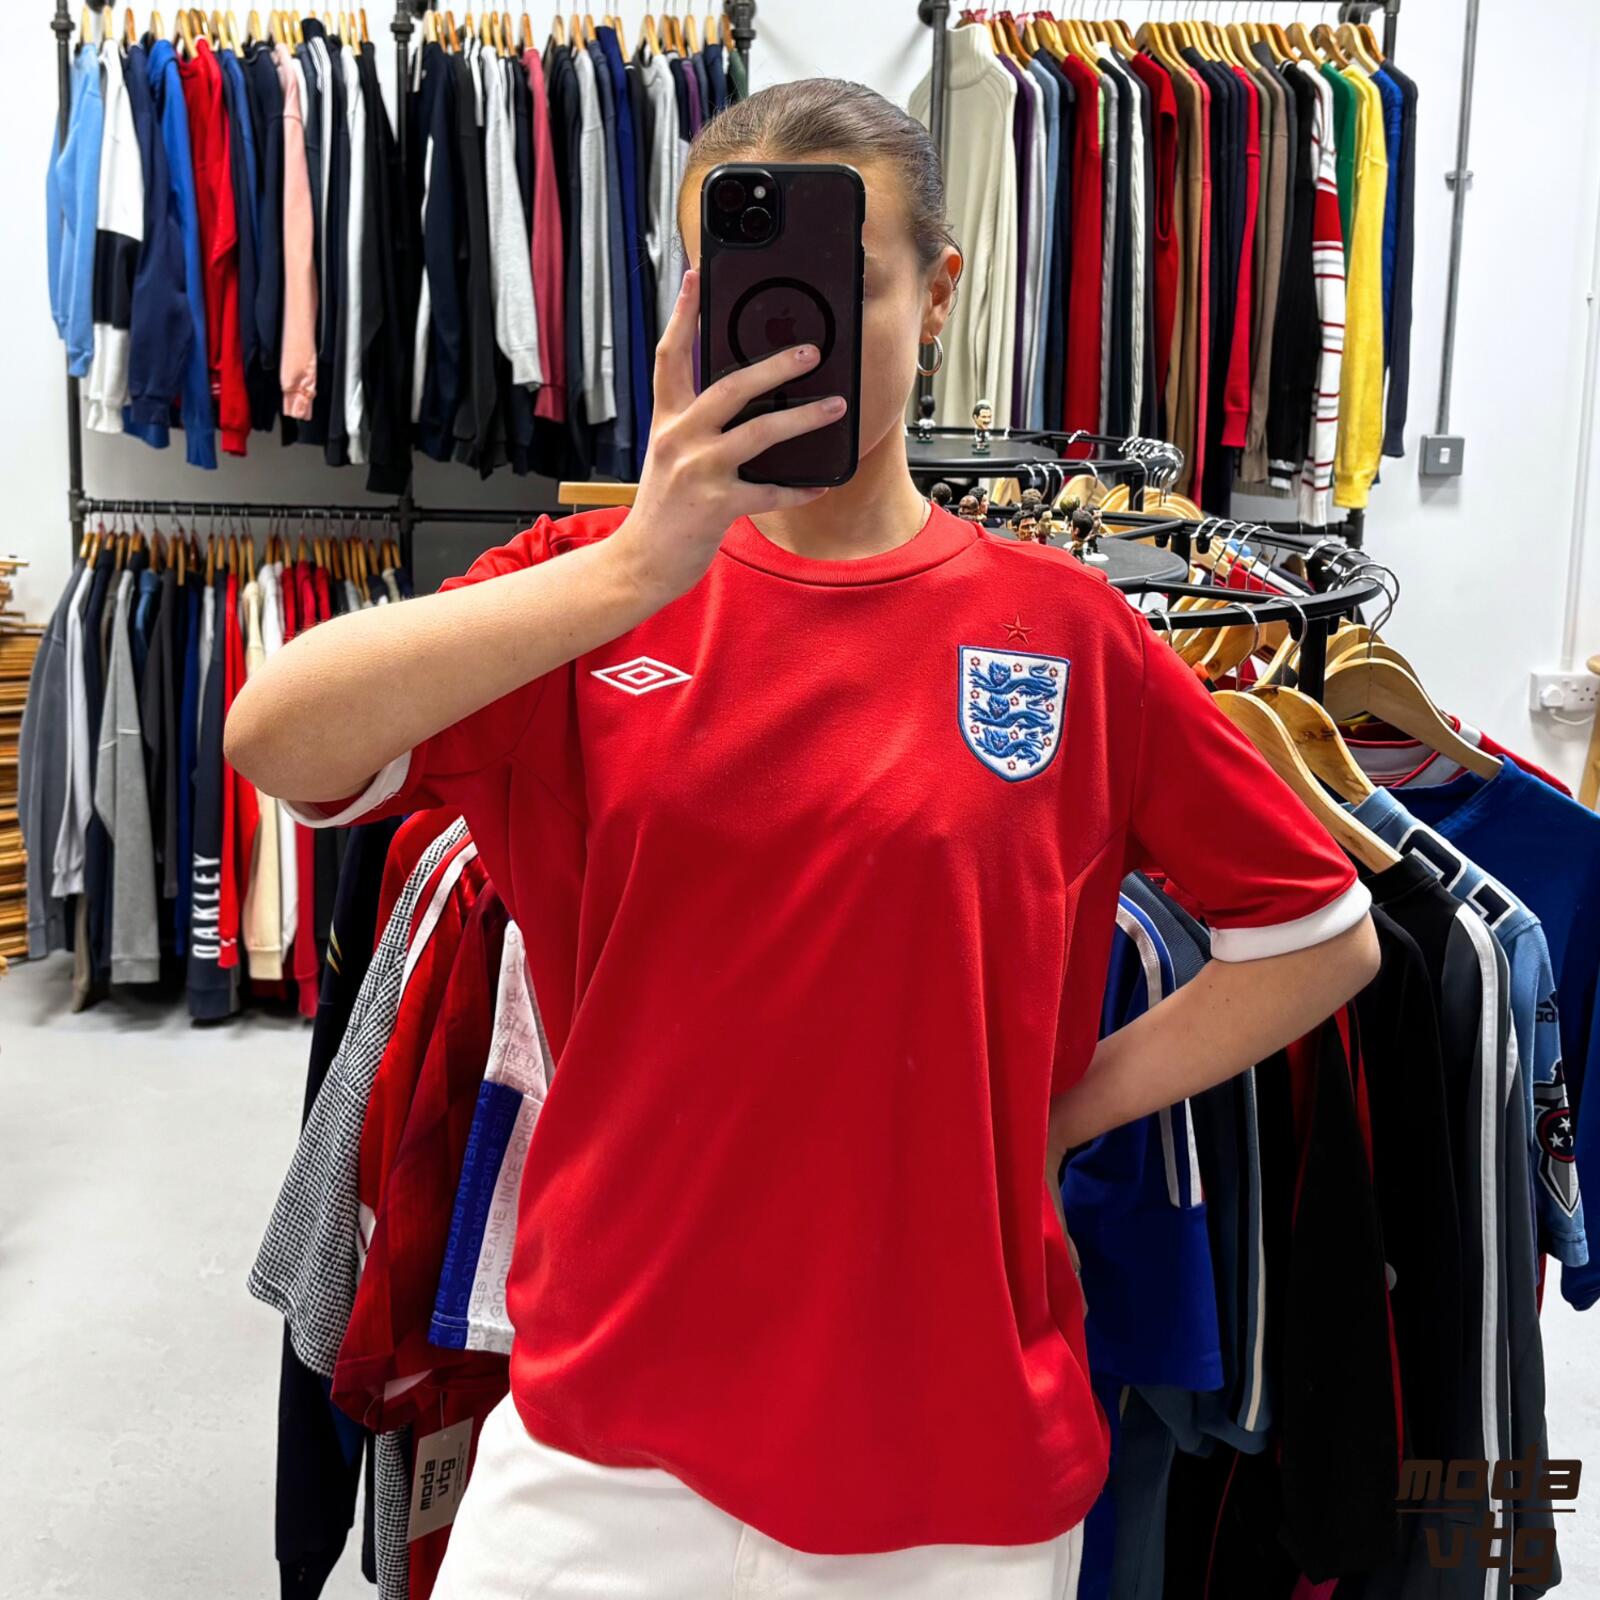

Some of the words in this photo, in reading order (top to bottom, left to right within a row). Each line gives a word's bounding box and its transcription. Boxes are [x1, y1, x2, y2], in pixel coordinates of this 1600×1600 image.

[193, 853, 221, 959] OAKLEY
[480, 1209, 507, 1272] KEANE
[498, 1160, 524, 1204] INCE
[420, 1459, 436, 1511] moda
[435, 1457, 456, 1497] vtg
